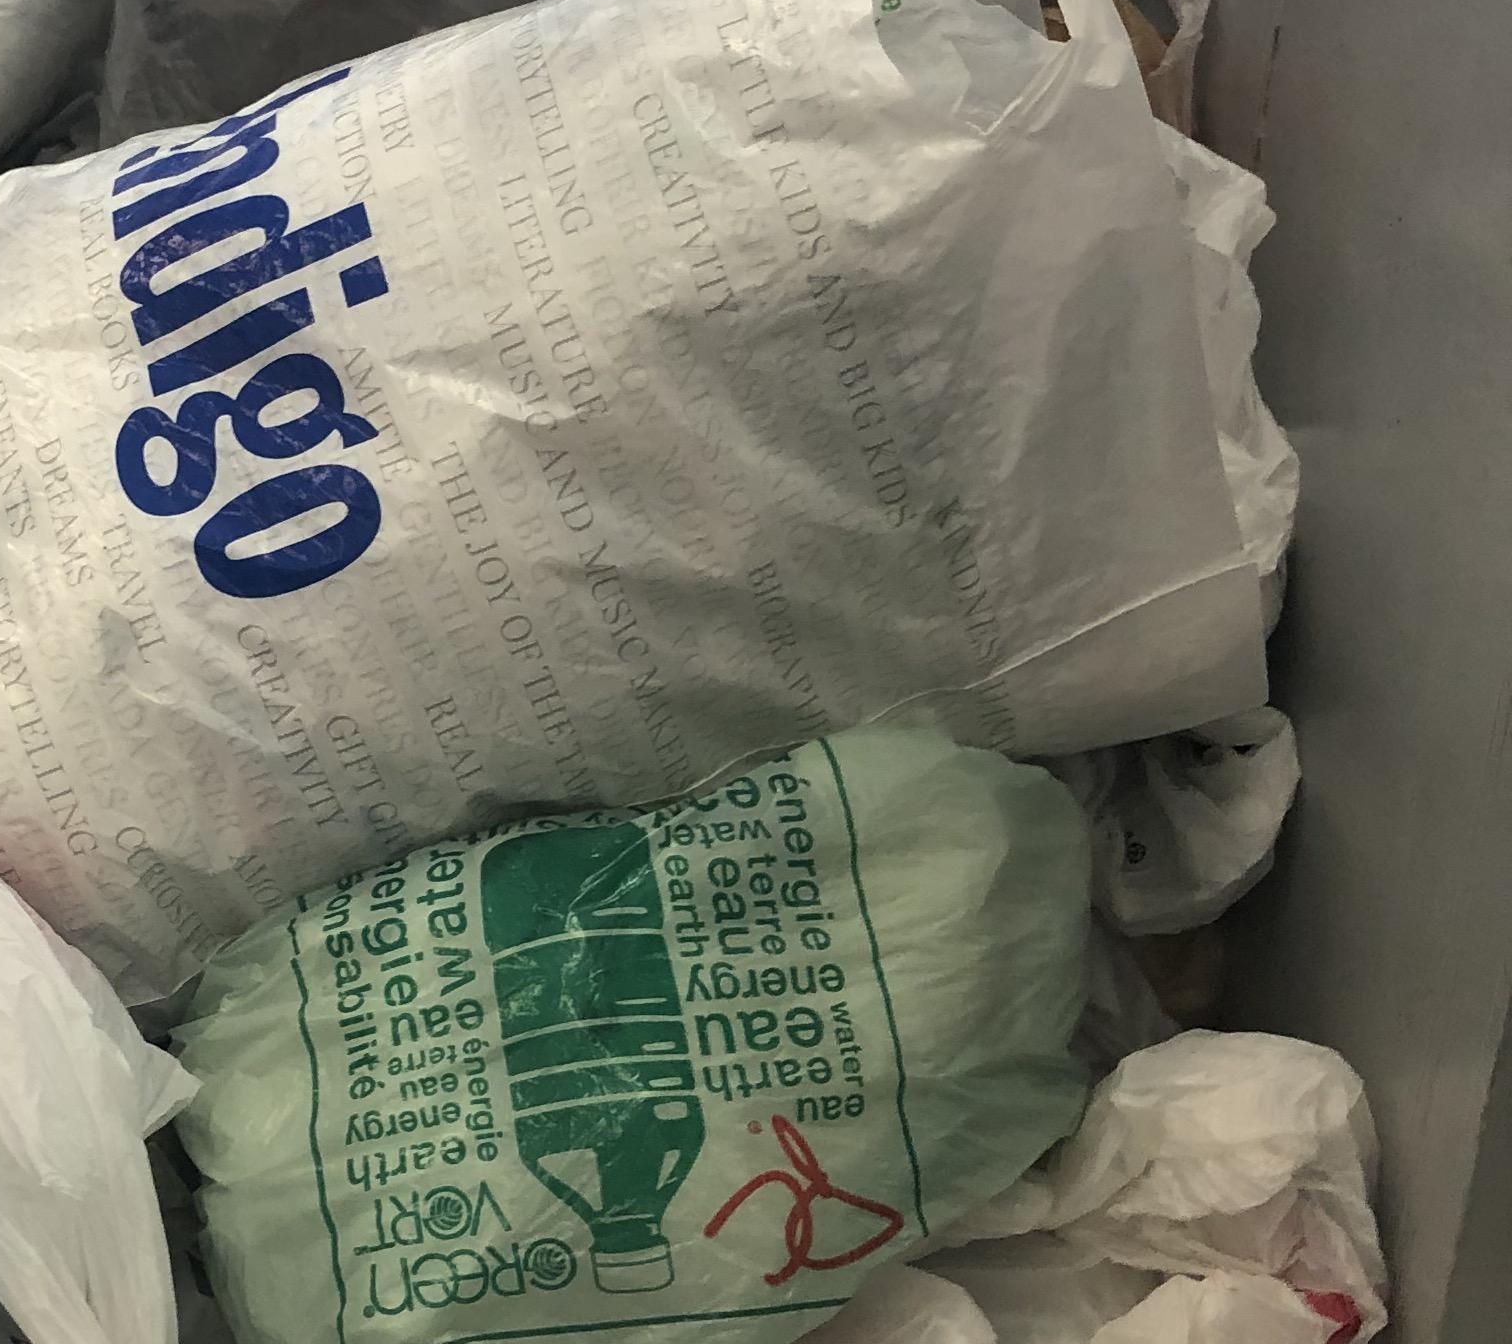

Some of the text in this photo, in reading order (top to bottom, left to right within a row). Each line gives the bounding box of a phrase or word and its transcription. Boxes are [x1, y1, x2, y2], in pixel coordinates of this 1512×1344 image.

[629, 91, 739, 321] CREATIVITY
[767, 158, 833, 263] KIDS
[77, 194, 142, 394] REAL BOOKS
[492, 171, 611, 426] LITERATURE
[803, 266, 863, 355] AND
[835, 359, 887, 431] BIG
[31, 436, 97, 588] DREAMS
[425, 440, 489, 535] THE
[481, 301, 561, 440] MUSIC
[534, 441, 598, 536] AND
[575, 539, 651, 664] MUSIC
[860, 434, 920, 531] KIDS
[93, 513, 173, 667] TRAVEL
[463, 534, 521, 612] JOY
[496, 611, 544, 667] OF
[234, 620, 348, 834] CREATIVITY
[421, 694, 488, 793] REAL
[519, 665, 578, 746] THE
[321, 711, 385, 798] GIFT
[654, 810, 771, 855] water
[764, 768, 836, 954] énergie
[409, 845, 485, 998] water
[662, 851, 711, 959] earth
[705, 853, 754, 958] eau
[744, 851, 788, 957] terre
[386, 996, 486, 1047] eau
[681, 944, 845, 1013] energy
[384, 1043, 458, 1076] terre
[691, 997, 827, 1065] eau
[701, 1048, 833, 1105] earth
[828, 997, 865, 1091] water
[340, 1097, 463, 1145] energy
[397, 1071, 460, 1101] eau
[453, 1034, 506, 1164] énergie
[793, 1089, 866, 1125] eau
[343, 1135, 470, 1193] earth
